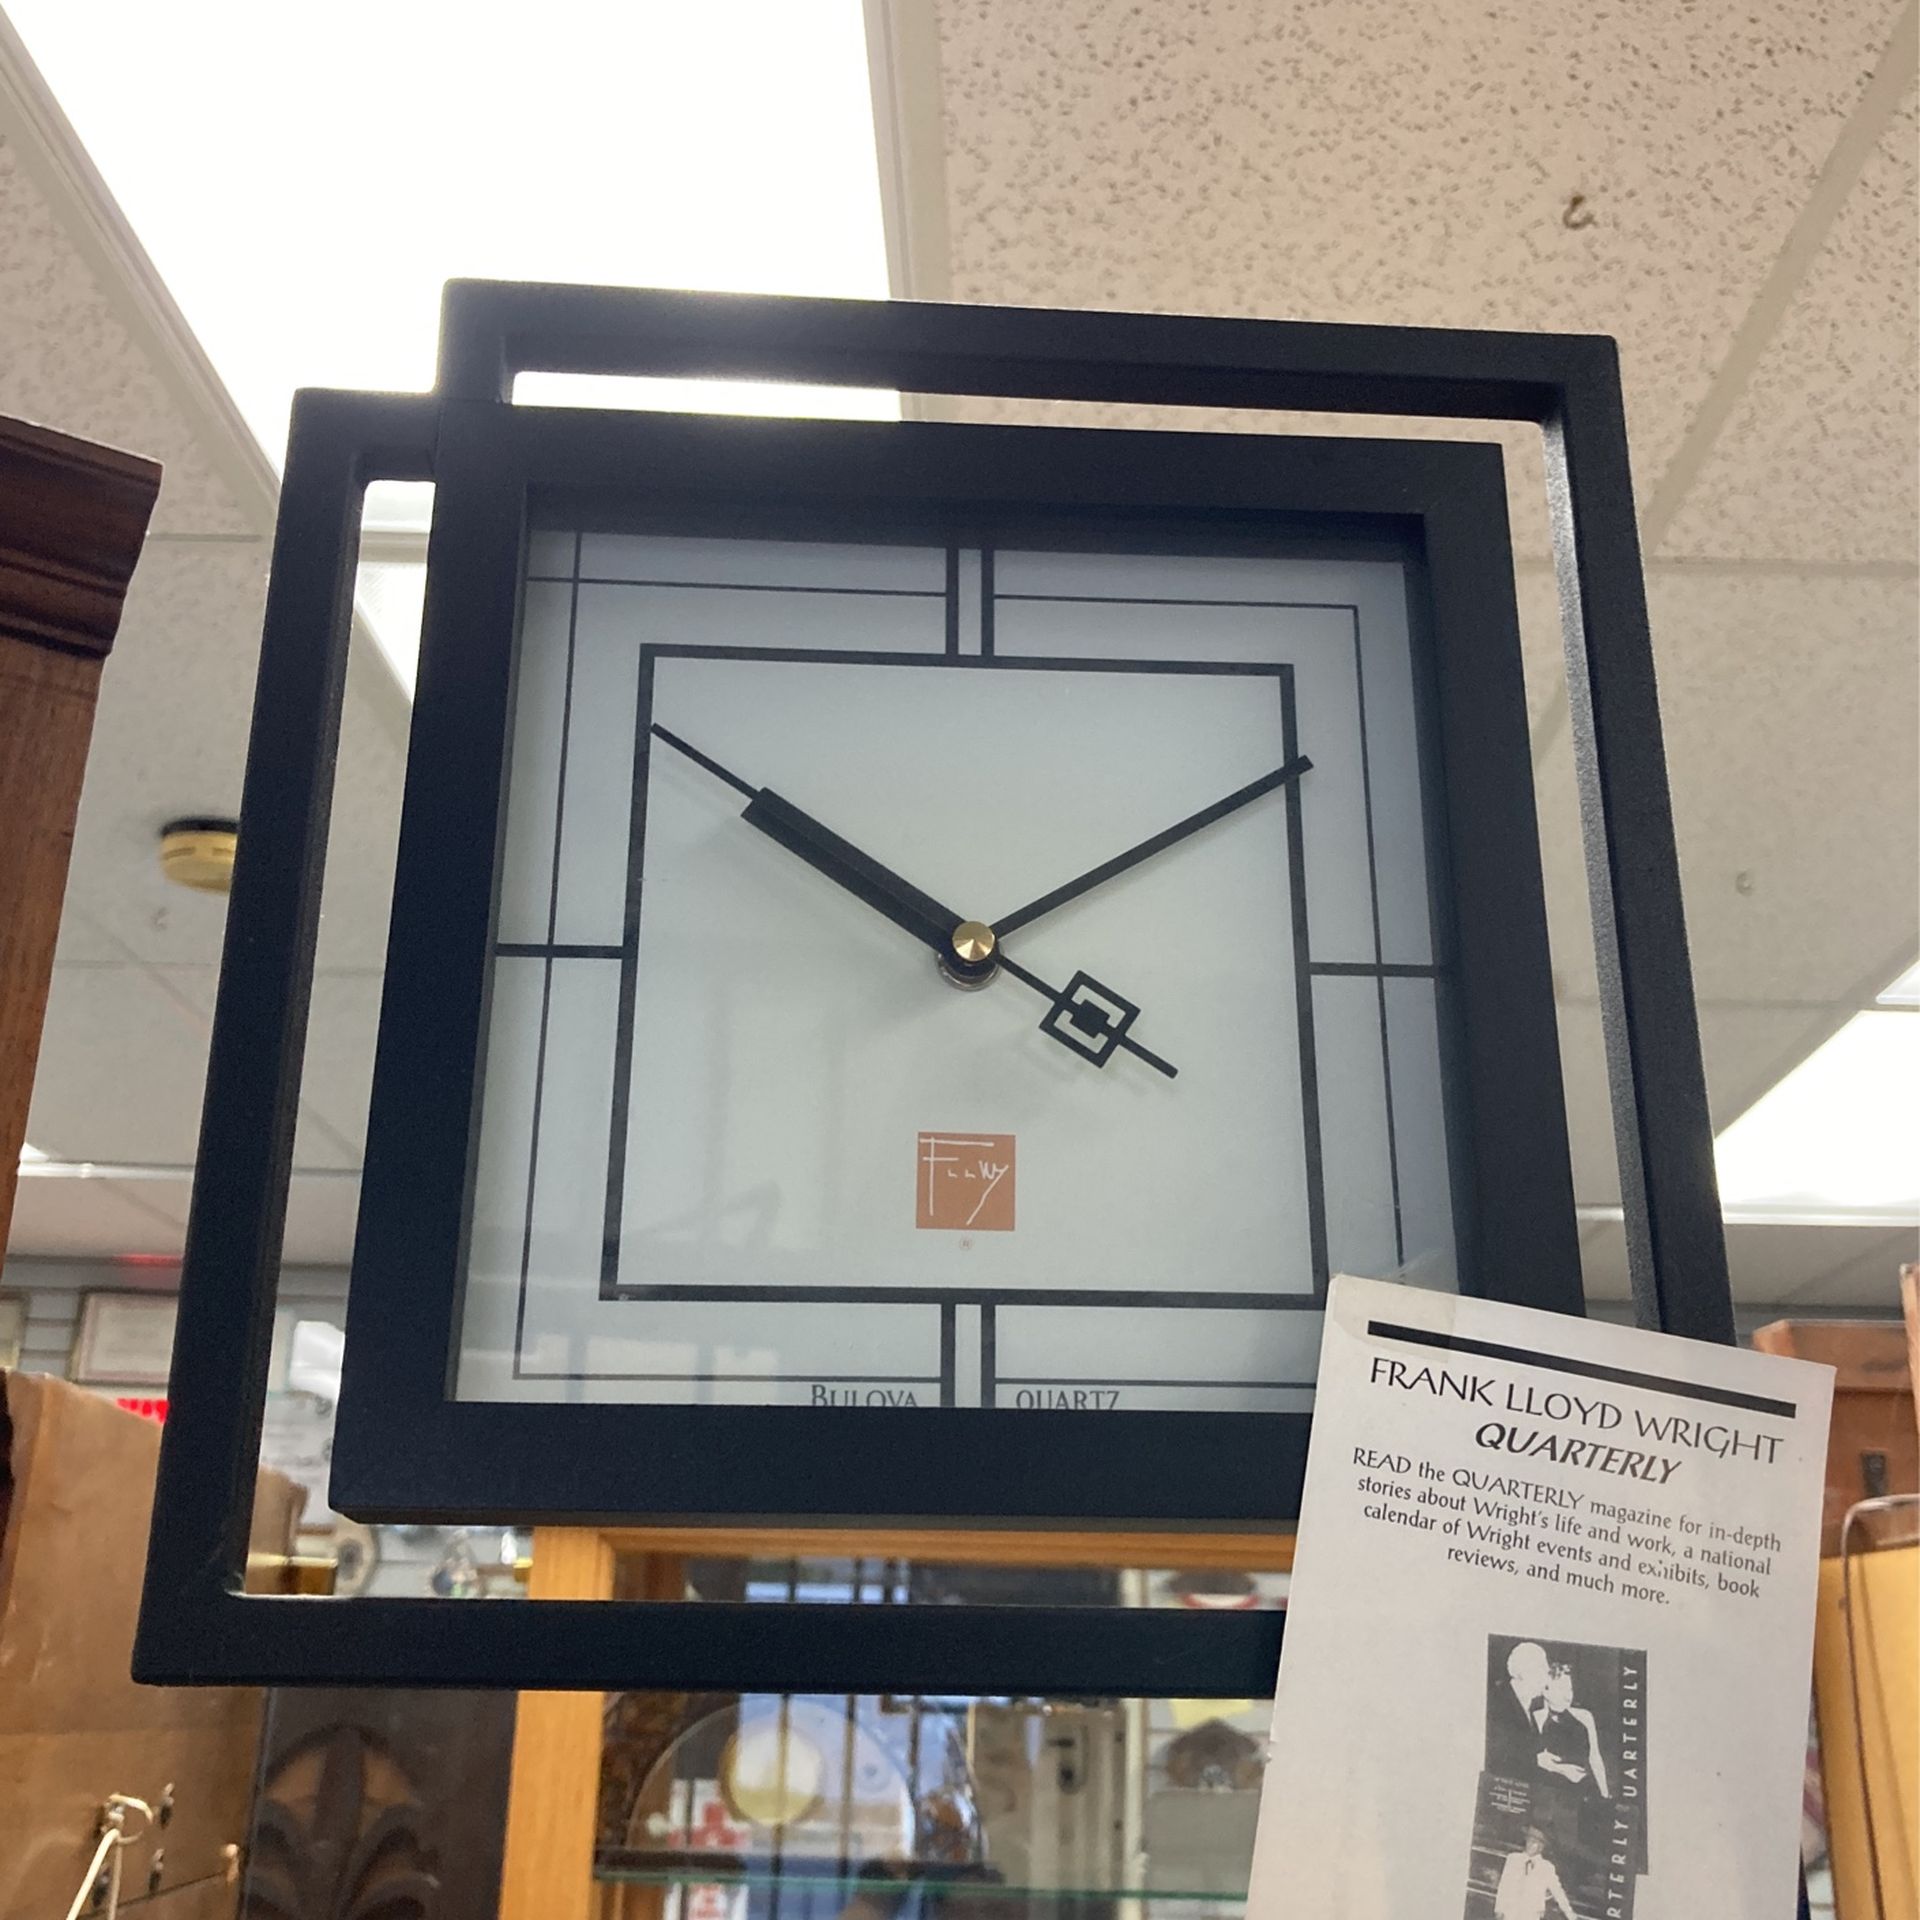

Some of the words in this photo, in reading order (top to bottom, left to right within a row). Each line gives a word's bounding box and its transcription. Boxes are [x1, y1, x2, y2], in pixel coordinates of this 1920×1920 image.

[1371, 1357, 1496, 1407] FRANK
[1506, 1383, 1623, 1430] LLOYD
[1634, 1409, 1785, 1464] WRIGHT
[1475, 1422, 1683, 1485] QUARTERLY
[1353, 1447, 1412, 1474] READ
[1418, 1461, 1445, 1482] the
[1452, 1468, 1585, 1509] QUARTERLY
[1590, 1500, 1672, 1529] magazine
[1679, 1514, 1703, 1535] for
[1708, 1522, 1782, 1552] in-depth
[1357, 1476, 1412, 1500] stories
[1417, 1487, 1466, 1511] about
[1473, 1497, 1549, 1529] Wright's
[1555, 1513, 1582, 1536] life
[1587, 1526, 1621, 1544] and
[1627, 1533, 1676, 1557] work,
[1683, 1545, 1694, 1559] a
[1700, 1548, 1771, 1575] national
[1364, 1502, 1437, 1531] calendar
[1442, 1518, 1462, 1536] of
[1467, 1521, 1531, 1551] Wright
[1536, 1539, 1592, 1563] events
[1598, 1553, 1631, 1571] and
[1717, 1572, 1760, 1598] book
[1447, 1547, 1520, 1576] reviews,
[1526, 1563, 1560, 1583] and
[1566, 1570, 1615, 1594] much
[1621, 1581, 1670, 1605] more.
